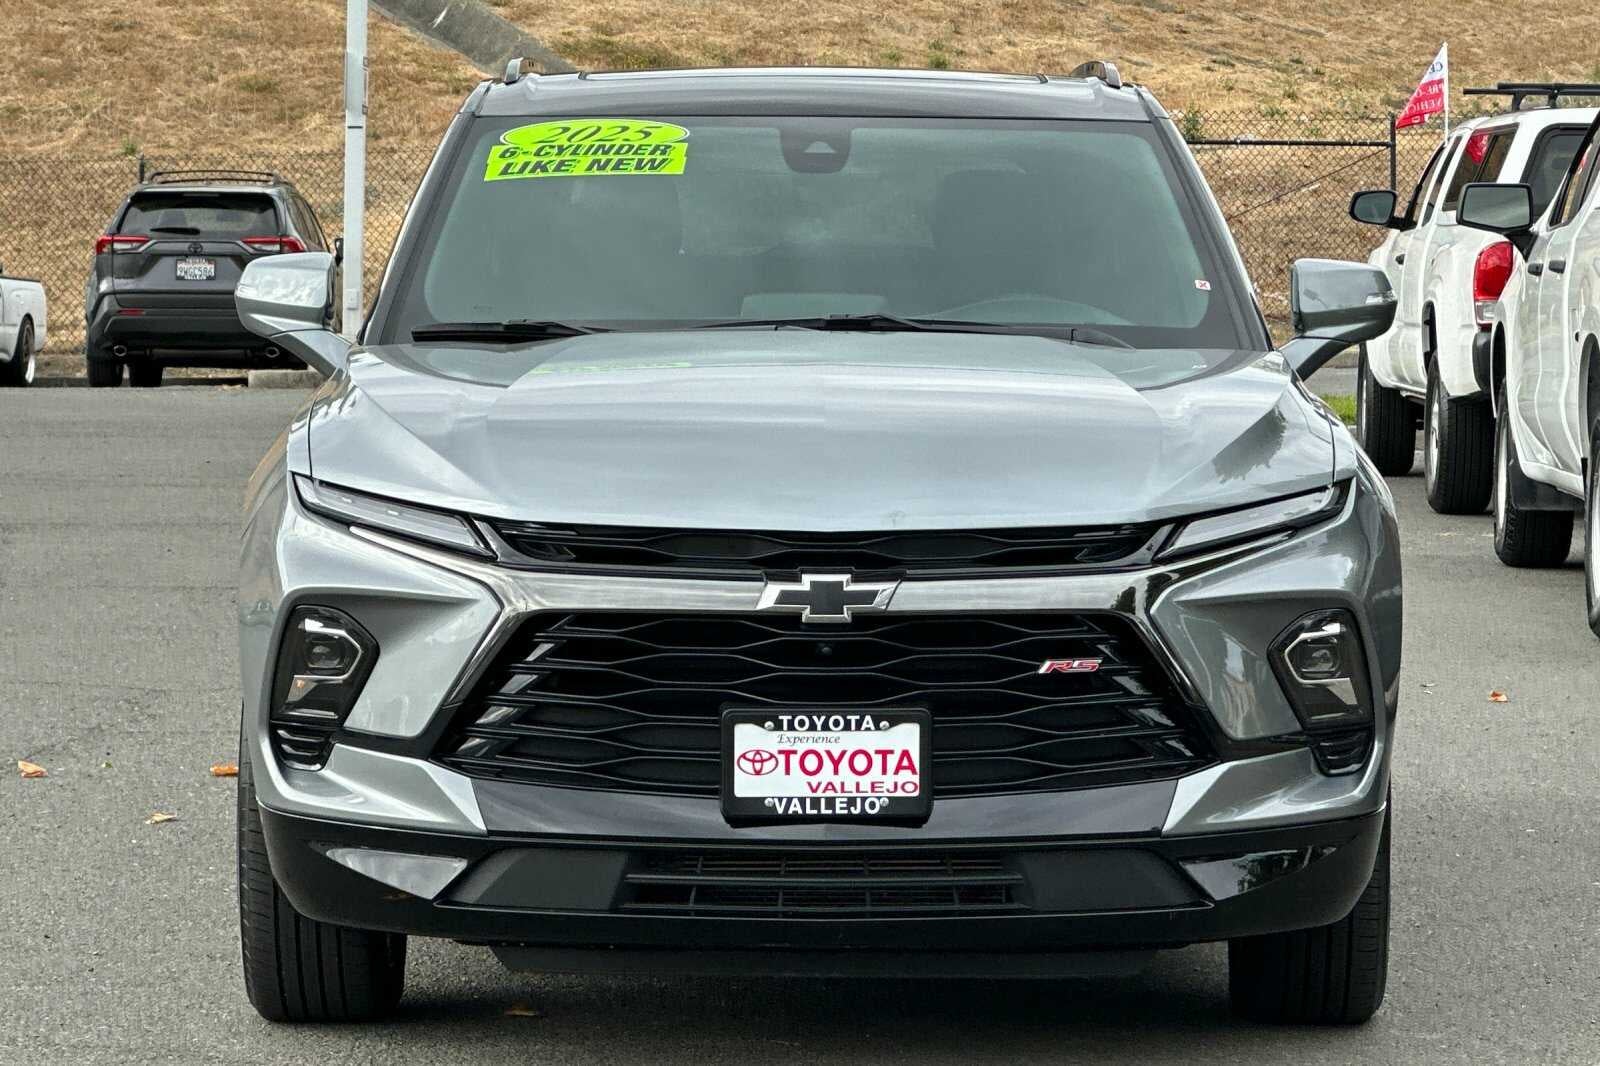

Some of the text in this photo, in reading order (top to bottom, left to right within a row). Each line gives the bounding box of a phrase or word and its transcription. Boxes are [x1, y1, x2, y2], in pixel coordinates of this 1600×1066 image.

[533, 125, 662, 144] 2025
[498, 143, 674, 158] 6-CYLINDER
[498, 157, 674, 175] LIKE NEW
[1039, 657, 1103, 673] RS
[778, 715, 875, 731] TOYOTA
[777, 733, 841, 747] Experience
[778, 749, 919, 776] TOYOTA
[807, 781, 919, 794] VALLEJO
[773, 797, 881, 815] VALLEJO
